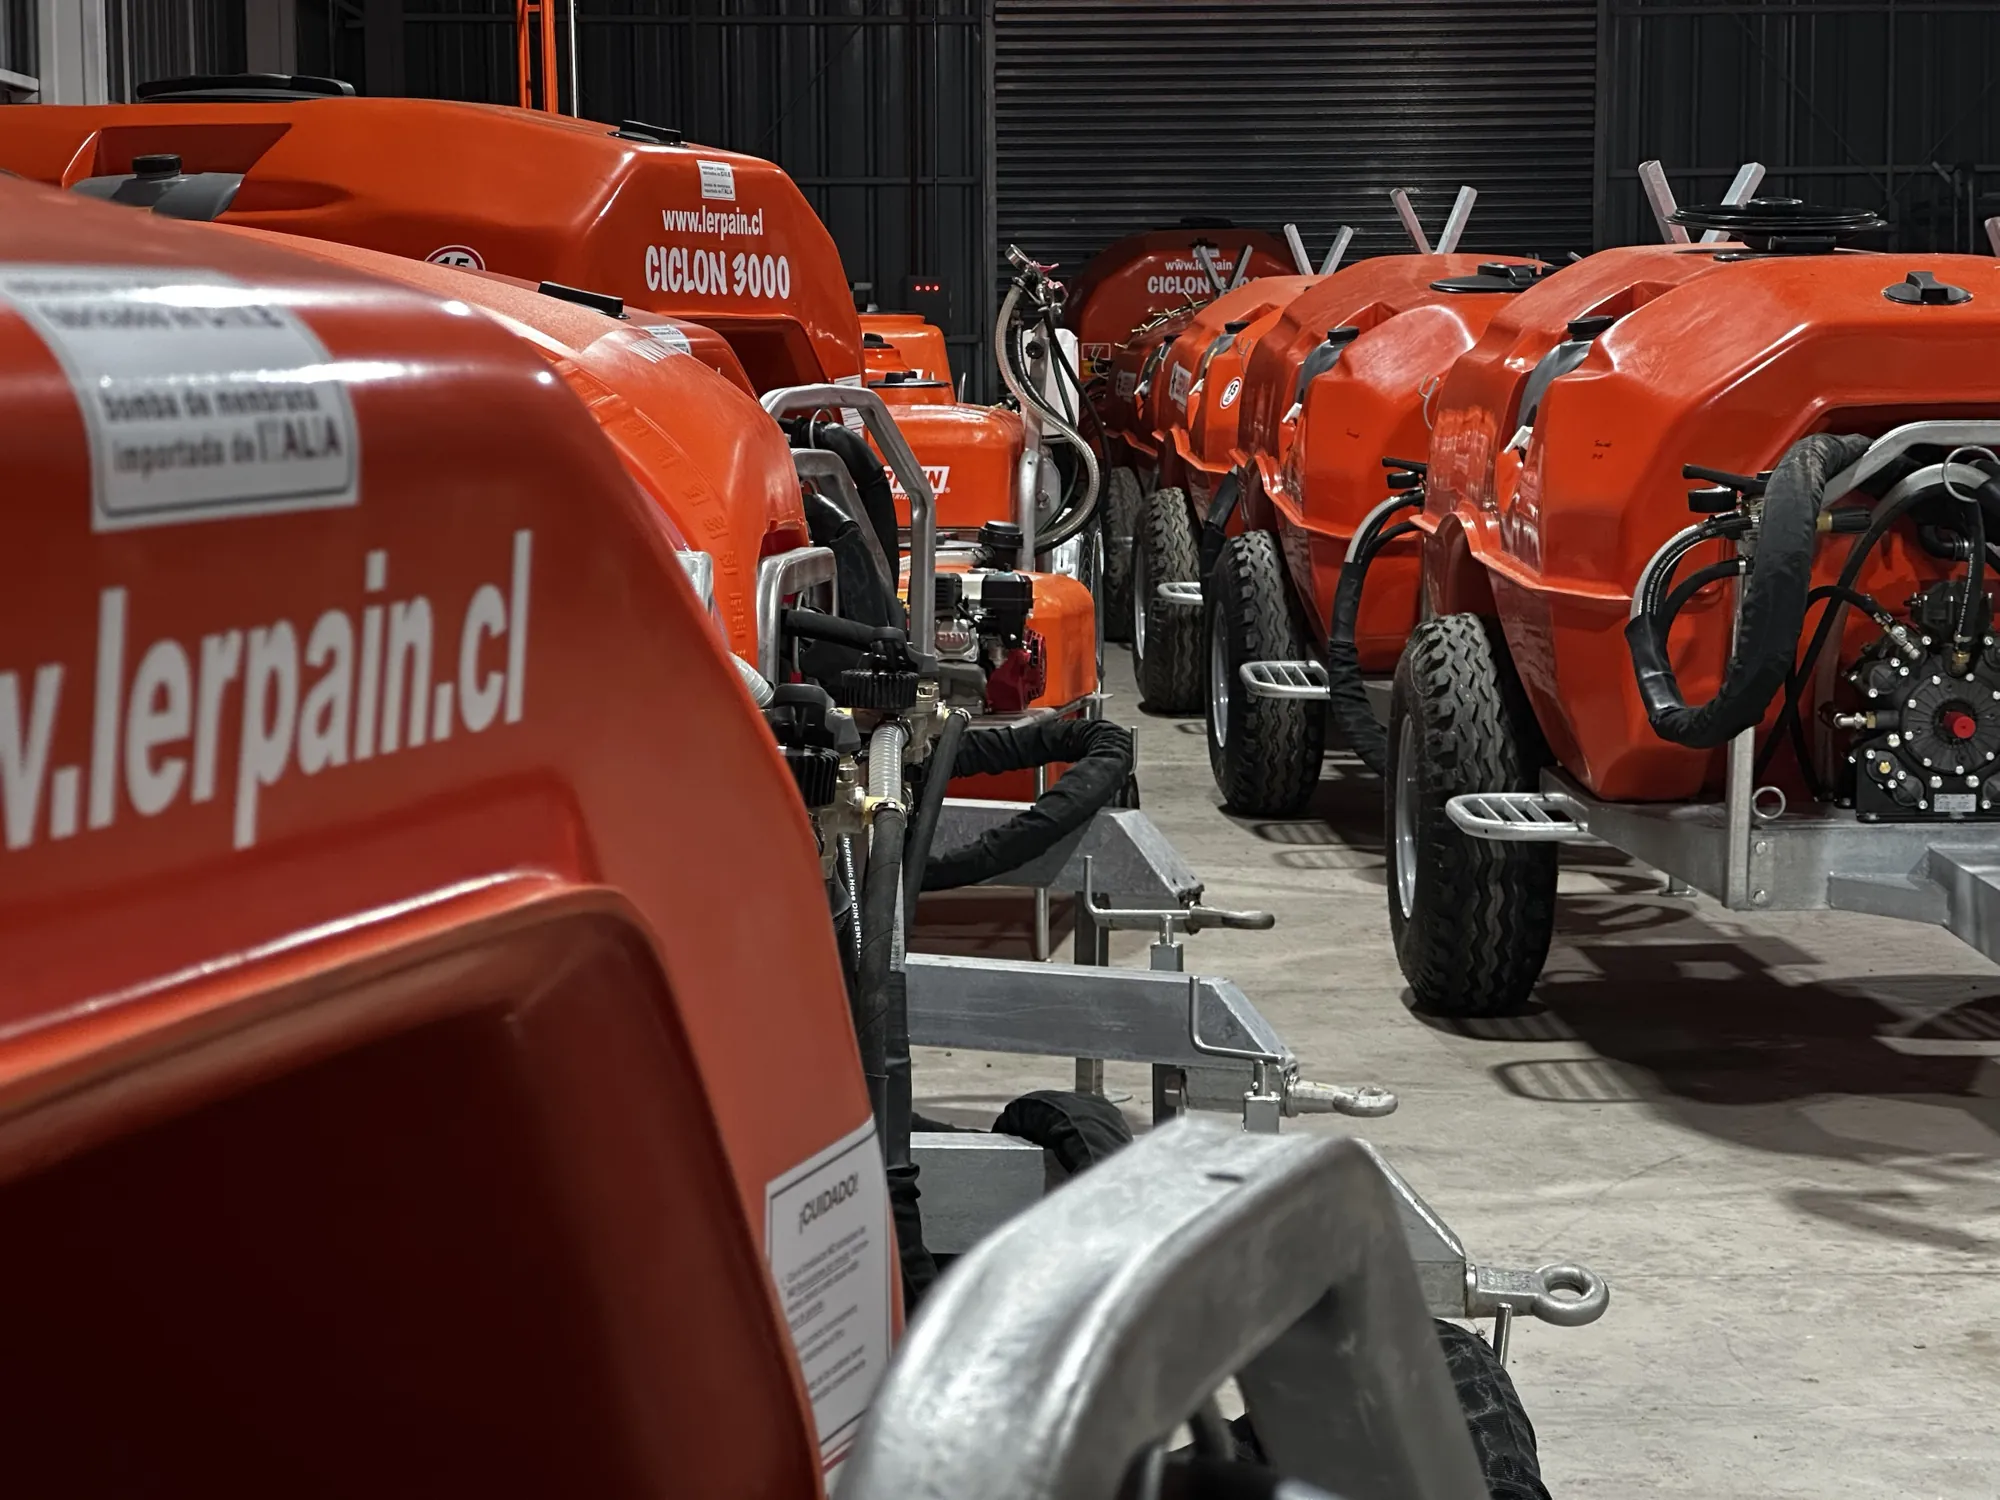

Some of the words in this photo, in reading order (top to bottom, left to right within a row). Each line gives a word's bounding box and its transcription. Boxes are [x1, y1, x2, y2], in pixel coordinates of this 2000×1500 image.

[662, 205, 763, 240] www.lerpain.cl
[645, 245, 728, 295] CICLON
[732, 252, 790, 299] 3000
[1147, 275, 1210, 294] CICLON
[843, 837, 854, 878] Hydraulic
